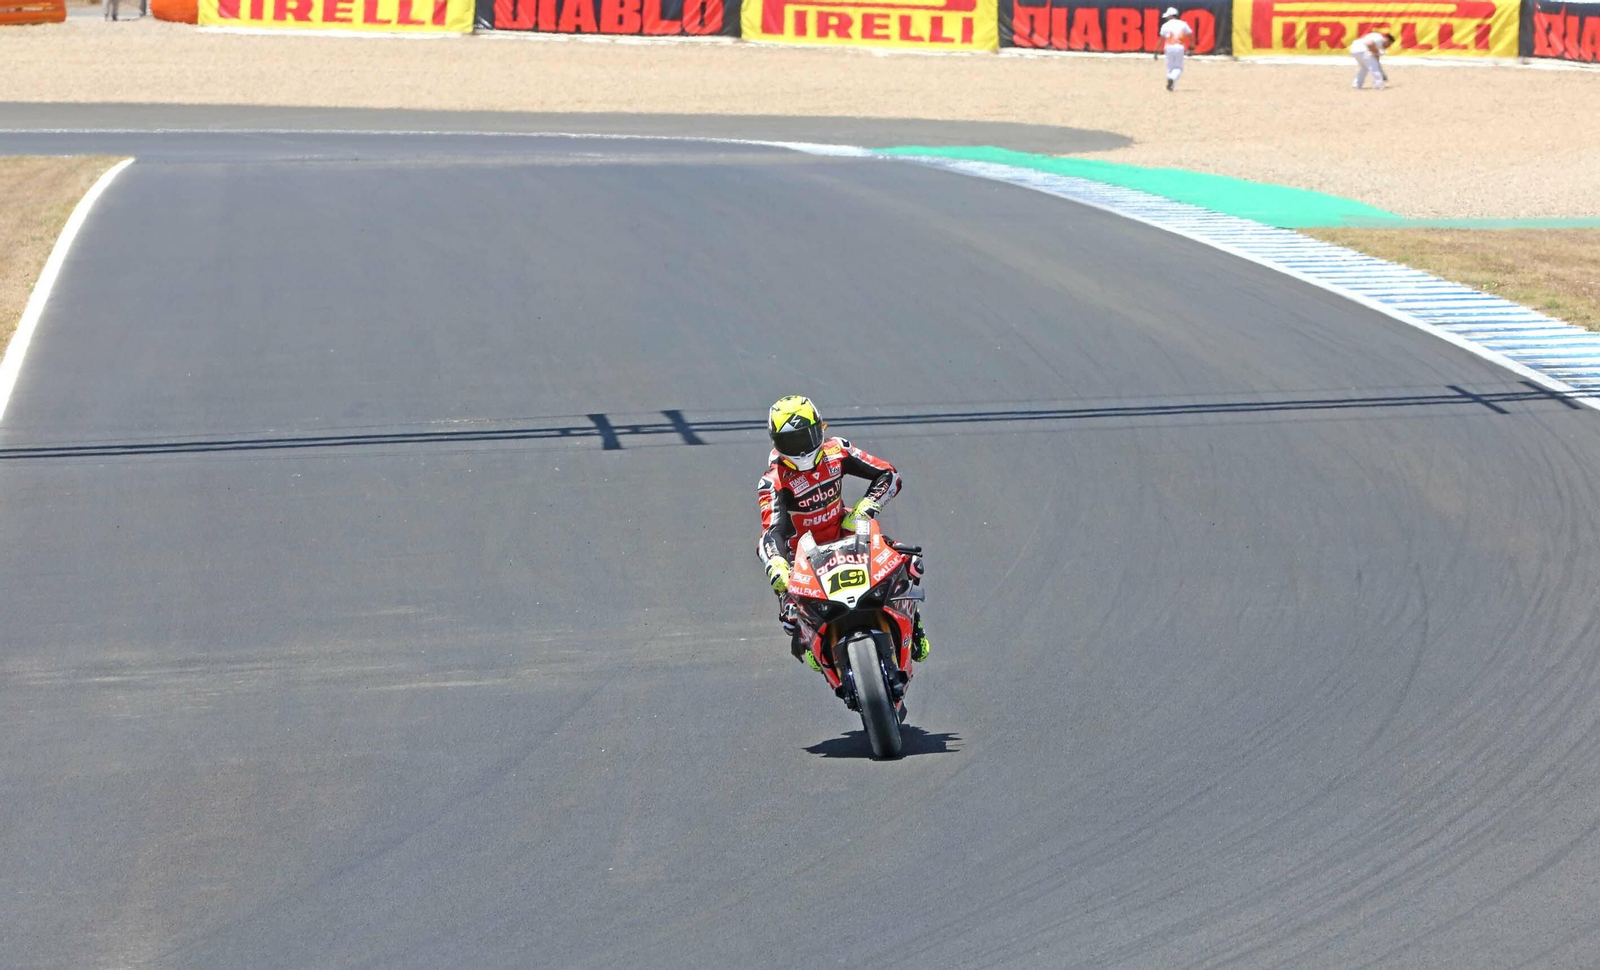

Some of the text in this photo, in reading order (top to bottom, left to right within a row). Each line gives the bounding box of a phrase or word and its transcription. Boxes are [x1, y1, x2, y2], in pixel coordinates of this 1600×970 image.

[493, 0, 724, 35] DIABLO
[761, 0, 978, 44] PIRELLI
[816, 551, 869, 576] aruba.it
[827, 569, 866, 595] 19
